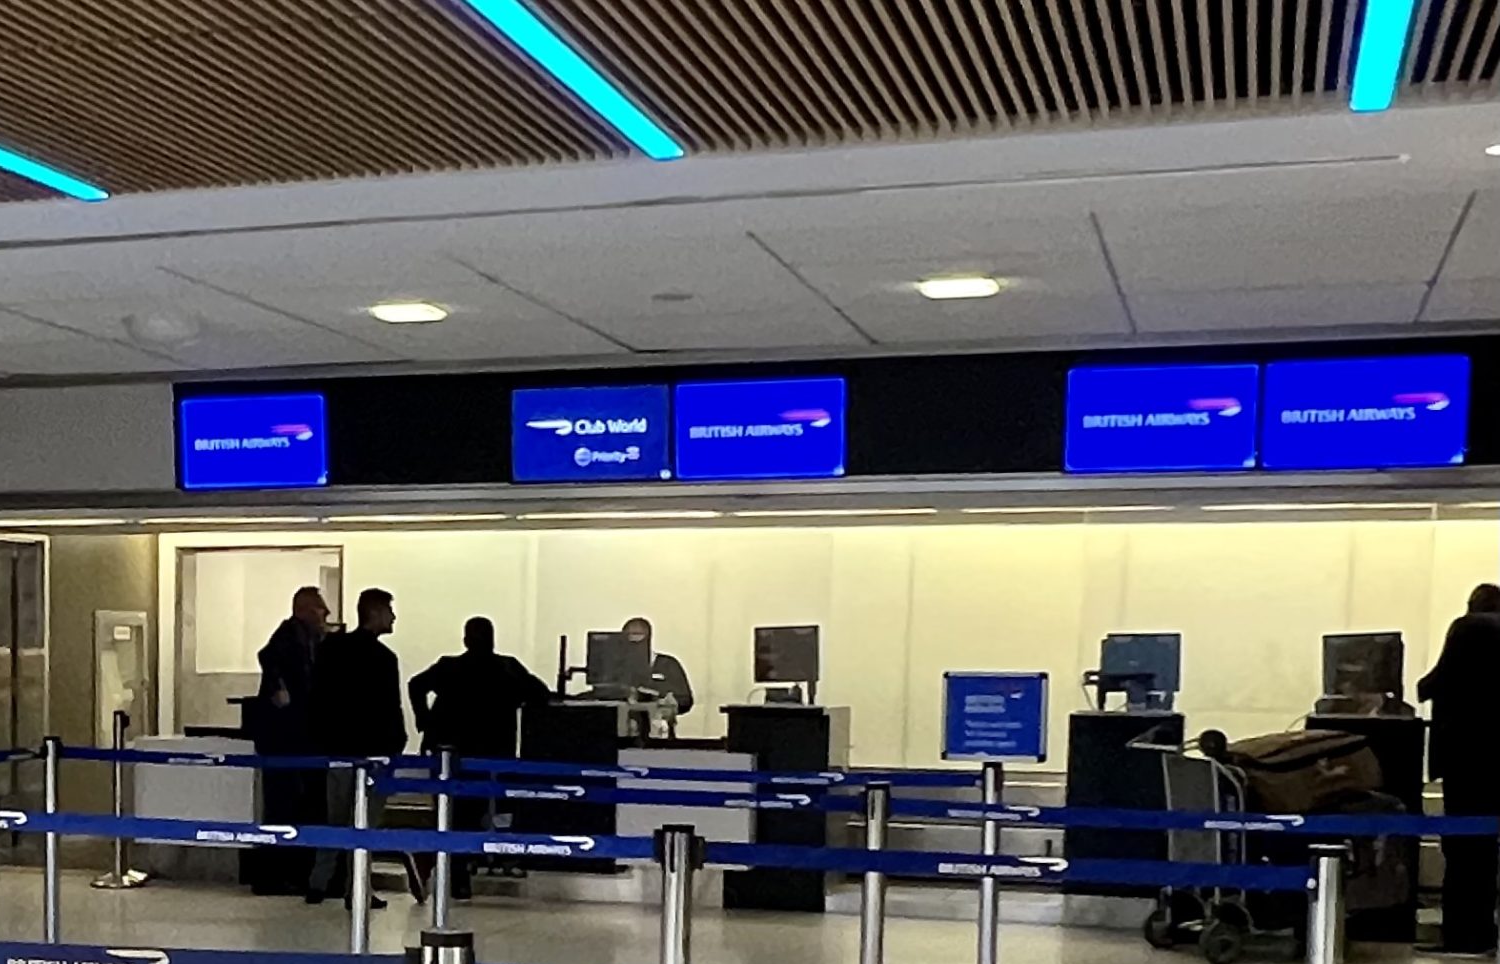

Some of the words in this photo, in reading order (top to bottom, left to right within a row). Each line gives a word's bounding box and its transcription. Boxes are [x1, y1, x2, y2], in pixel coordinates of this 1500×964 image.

[1280, 409, 1344, 424] BRITISH
[1346, 406, 1417, 421] AIRWAYS
[574, 419, 606, 435] Club
[607, 417, 648, 433] World
